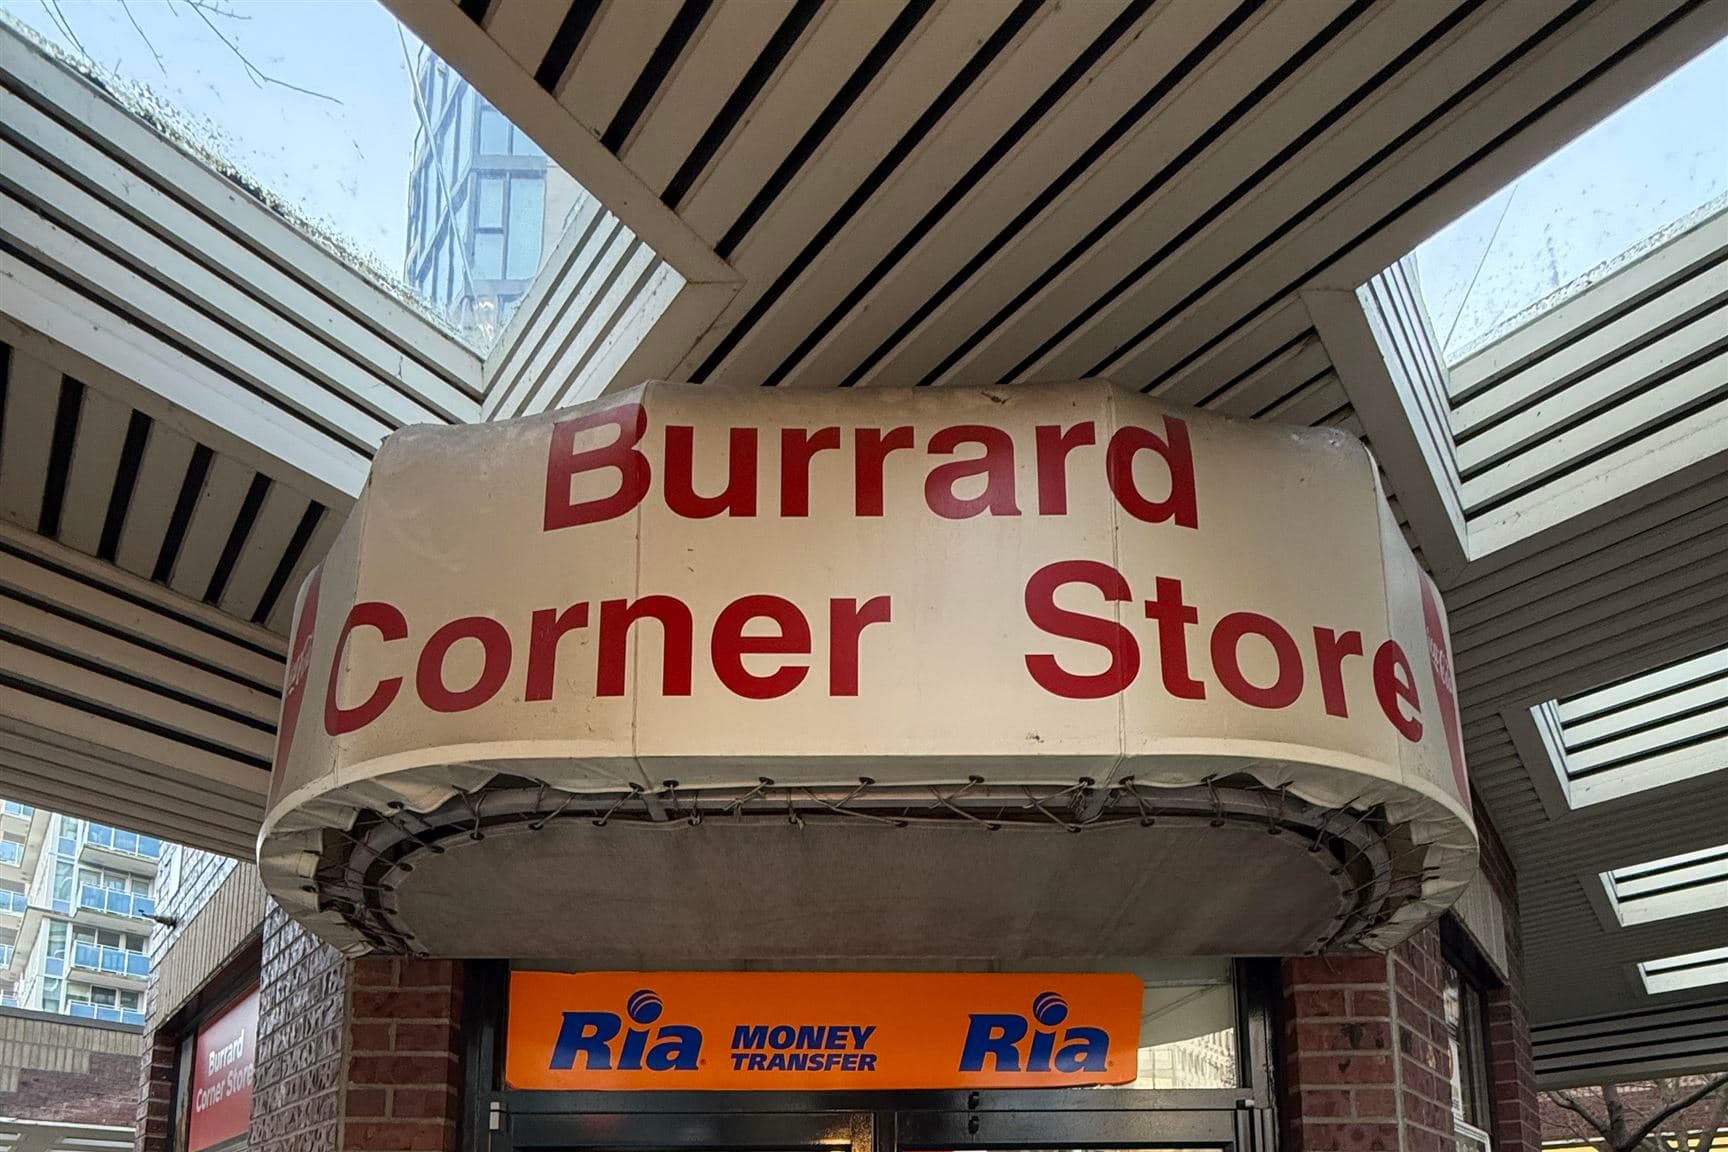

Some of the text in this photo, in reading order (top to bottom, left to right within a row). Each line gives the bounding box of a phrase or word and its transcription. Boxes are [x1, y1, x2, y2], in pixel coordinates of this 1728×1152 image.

[544, 402, 1199, 531] Burrard
[325, 559, 1425, 744] Corner Store
[208, 1028, 245, 1077] Burrard
[549, 989, 703, 1071] Ria
[731, 1025, 877, 1049] MONEY
[731, 1053, 877, 1071] TRANSFER
[958, 991, 1110, 1073] Ria
[196, 1063, 254, 1113] Corner Store
